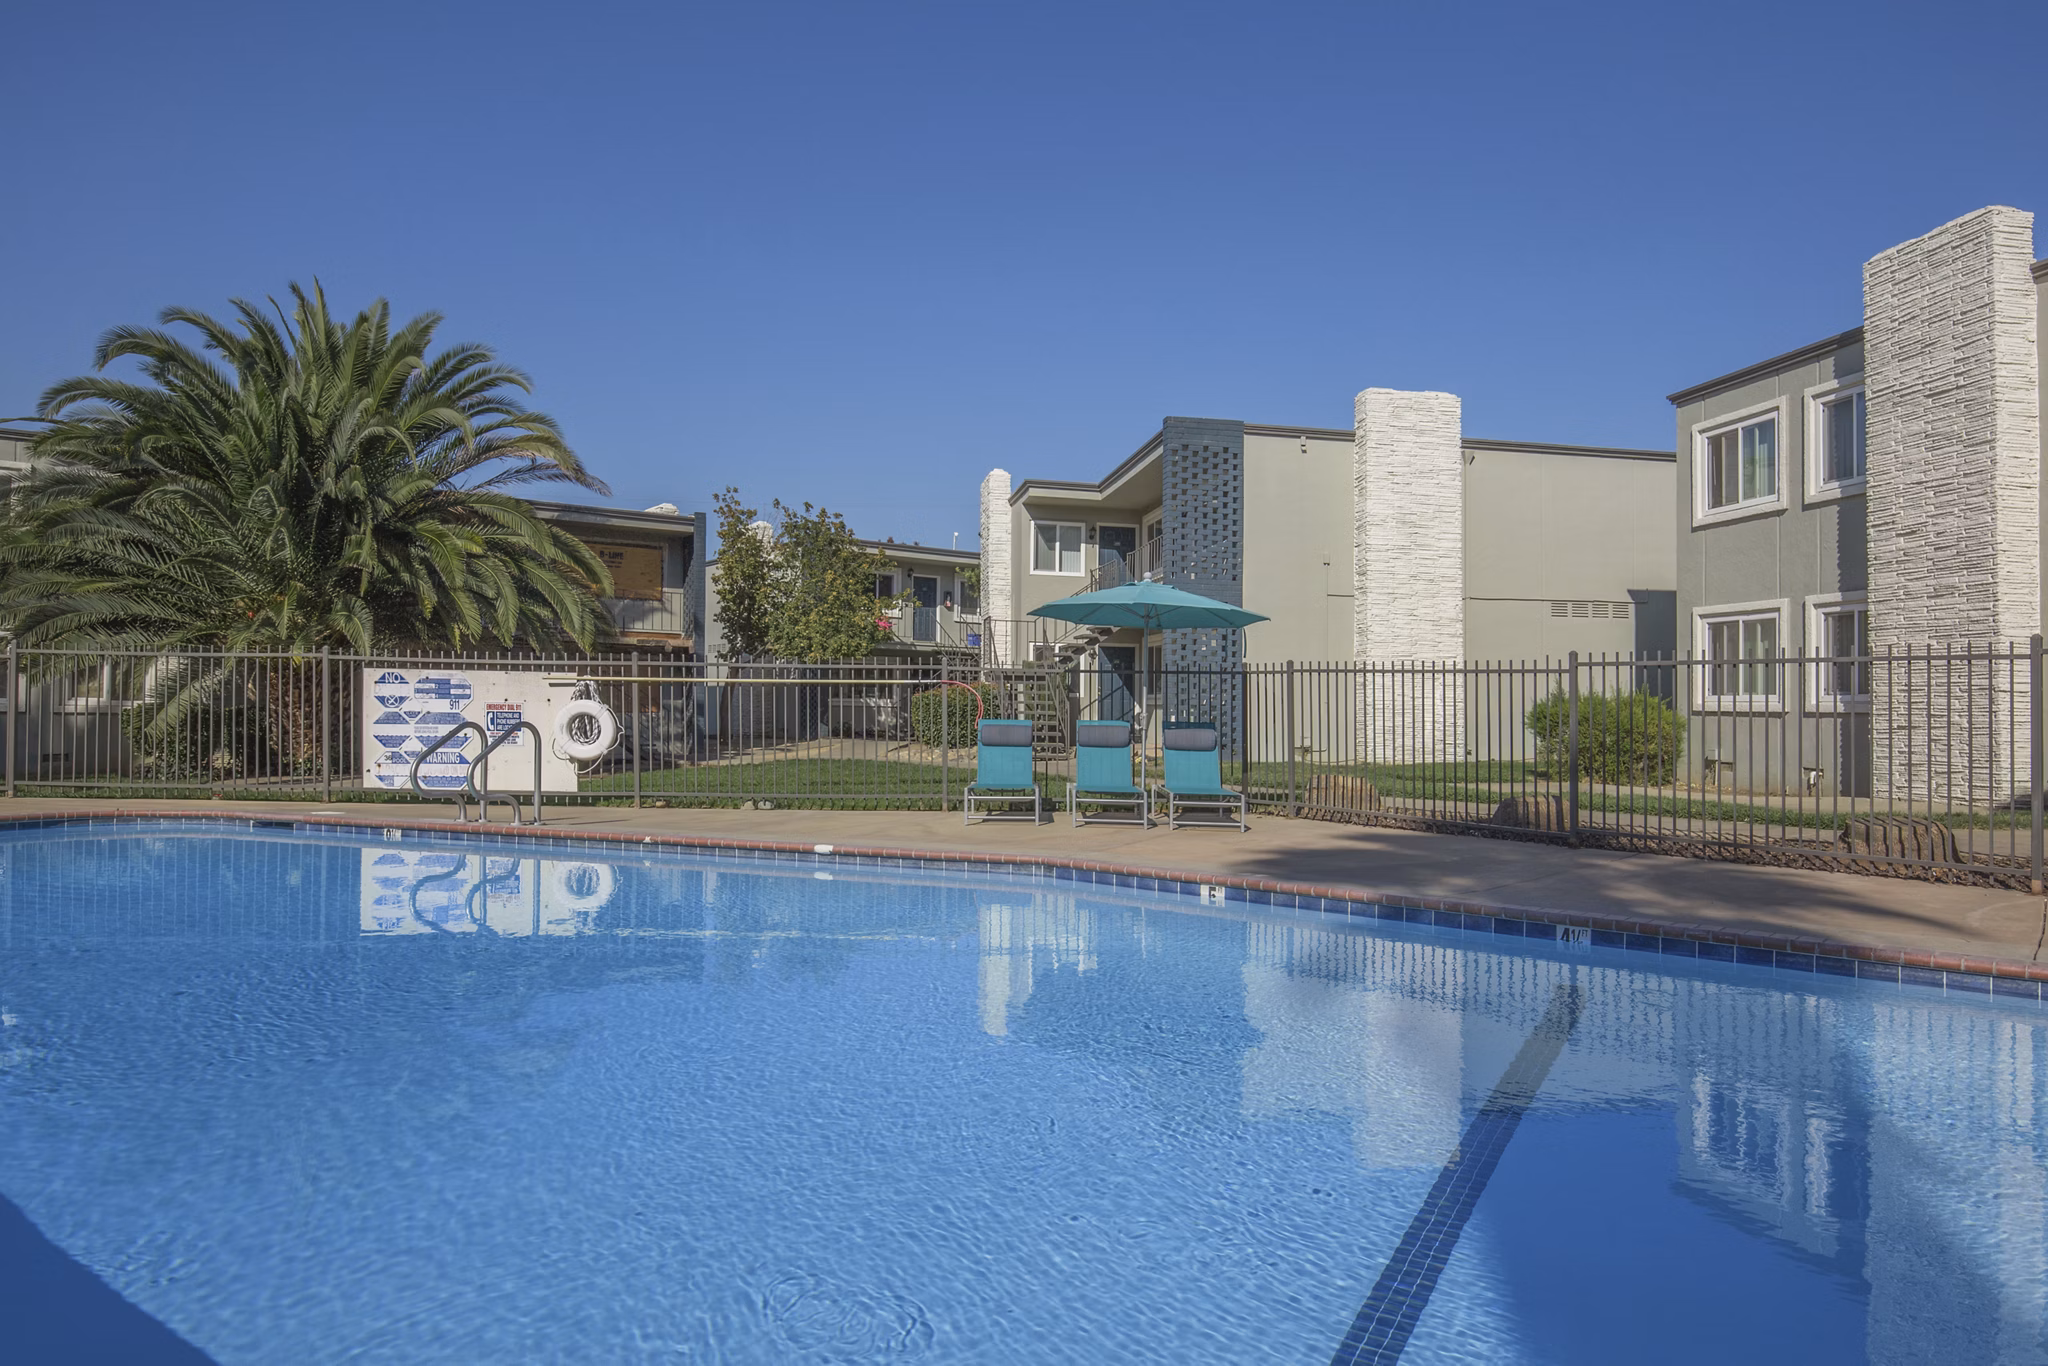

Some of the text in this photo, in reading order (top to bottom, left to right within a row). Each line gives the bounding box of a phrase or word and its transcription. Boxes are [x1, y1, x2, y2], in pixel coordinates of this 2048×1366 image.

[385, 672, 400, 683] NO
[449, 699, 460, 710] 911
[426, 752, 460, 764] WARNING
